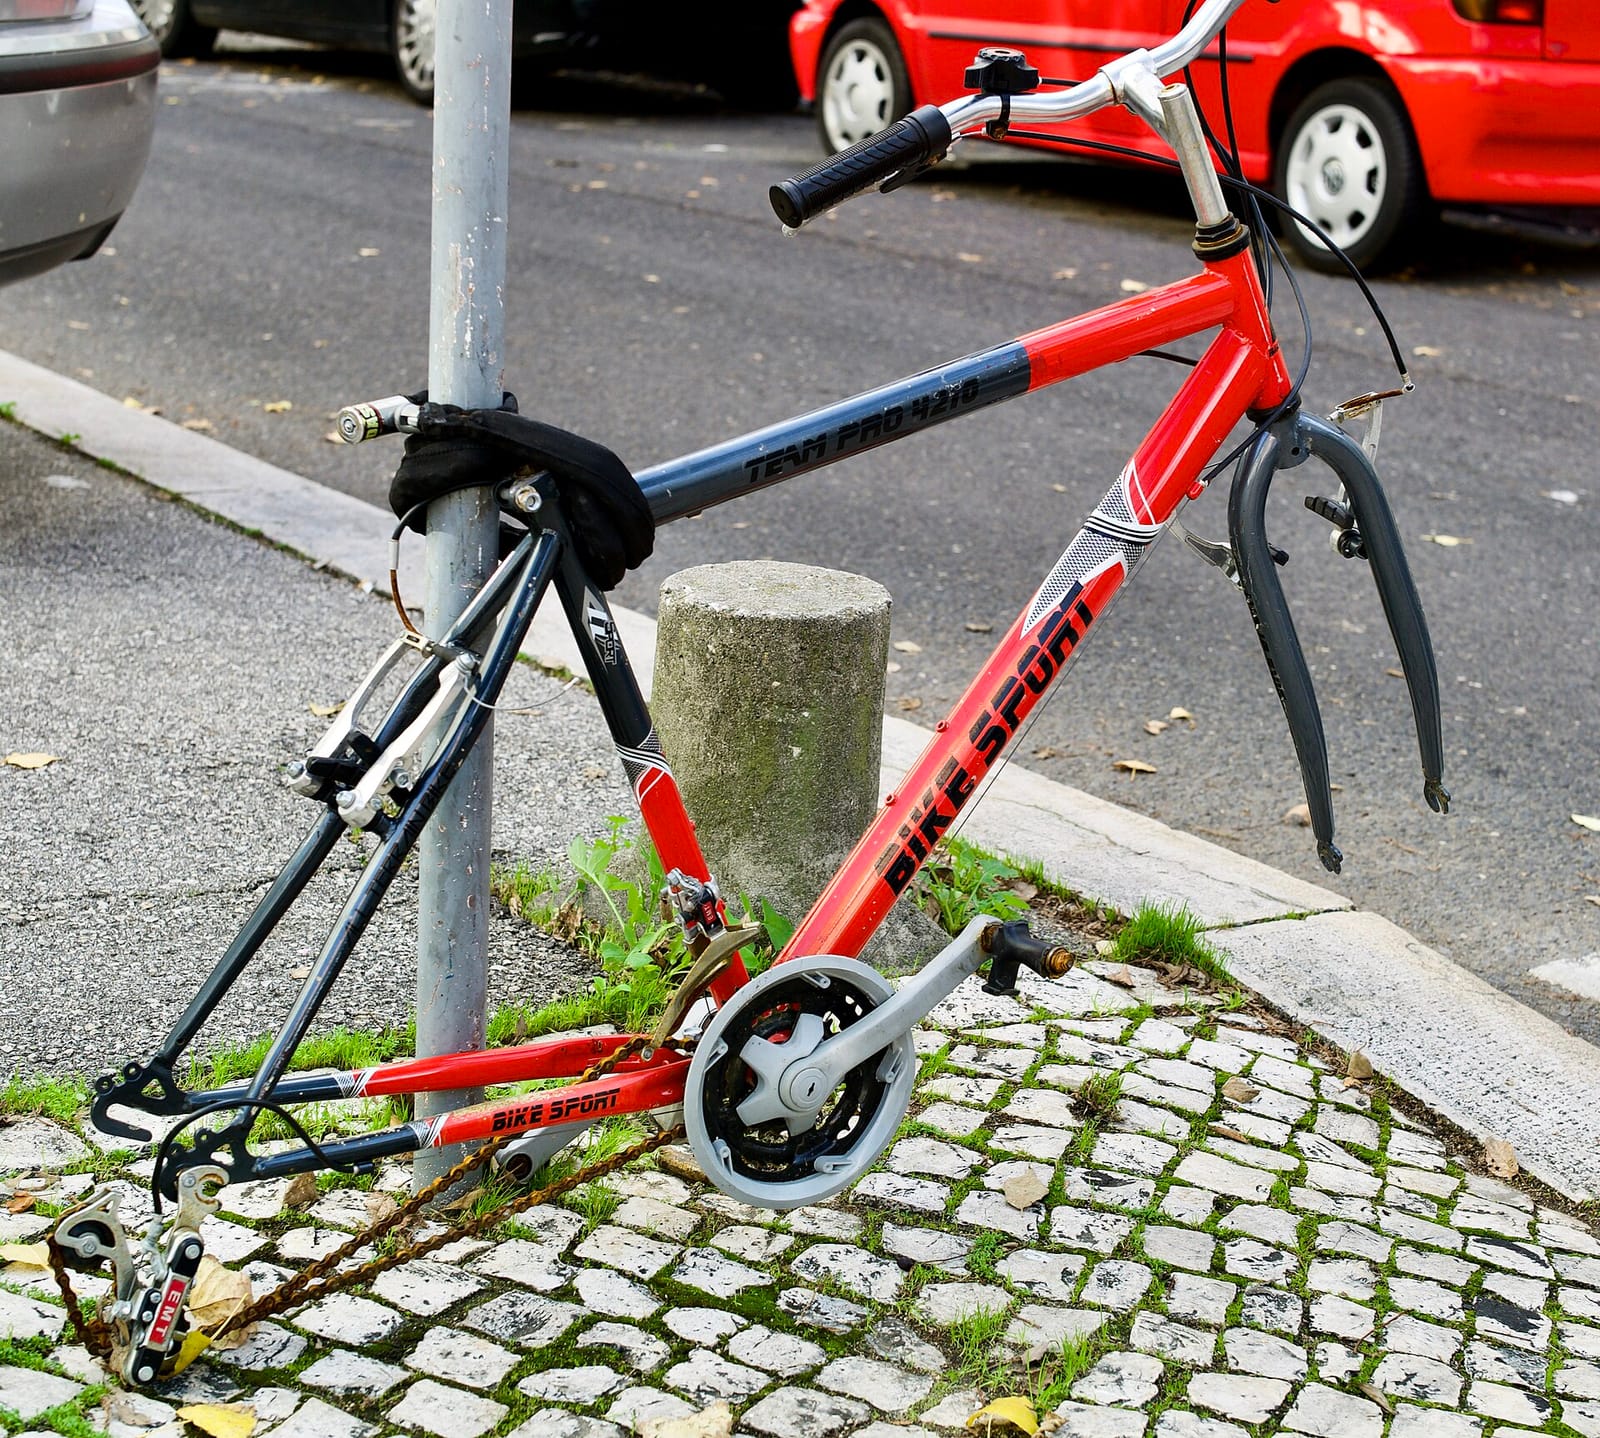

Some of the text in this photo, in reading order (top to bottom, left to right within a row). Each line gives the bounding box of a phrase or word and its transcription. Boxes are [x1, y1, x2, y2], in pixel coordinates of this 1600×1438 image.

[745, 378, 980, 484] TEAM PRO 4210
[874, 580, 1094, 897] BIKE SPORT
[492, 1088, 620, 1132] BIKE SPORT
[156, 1291, 181, 1338] EMT
